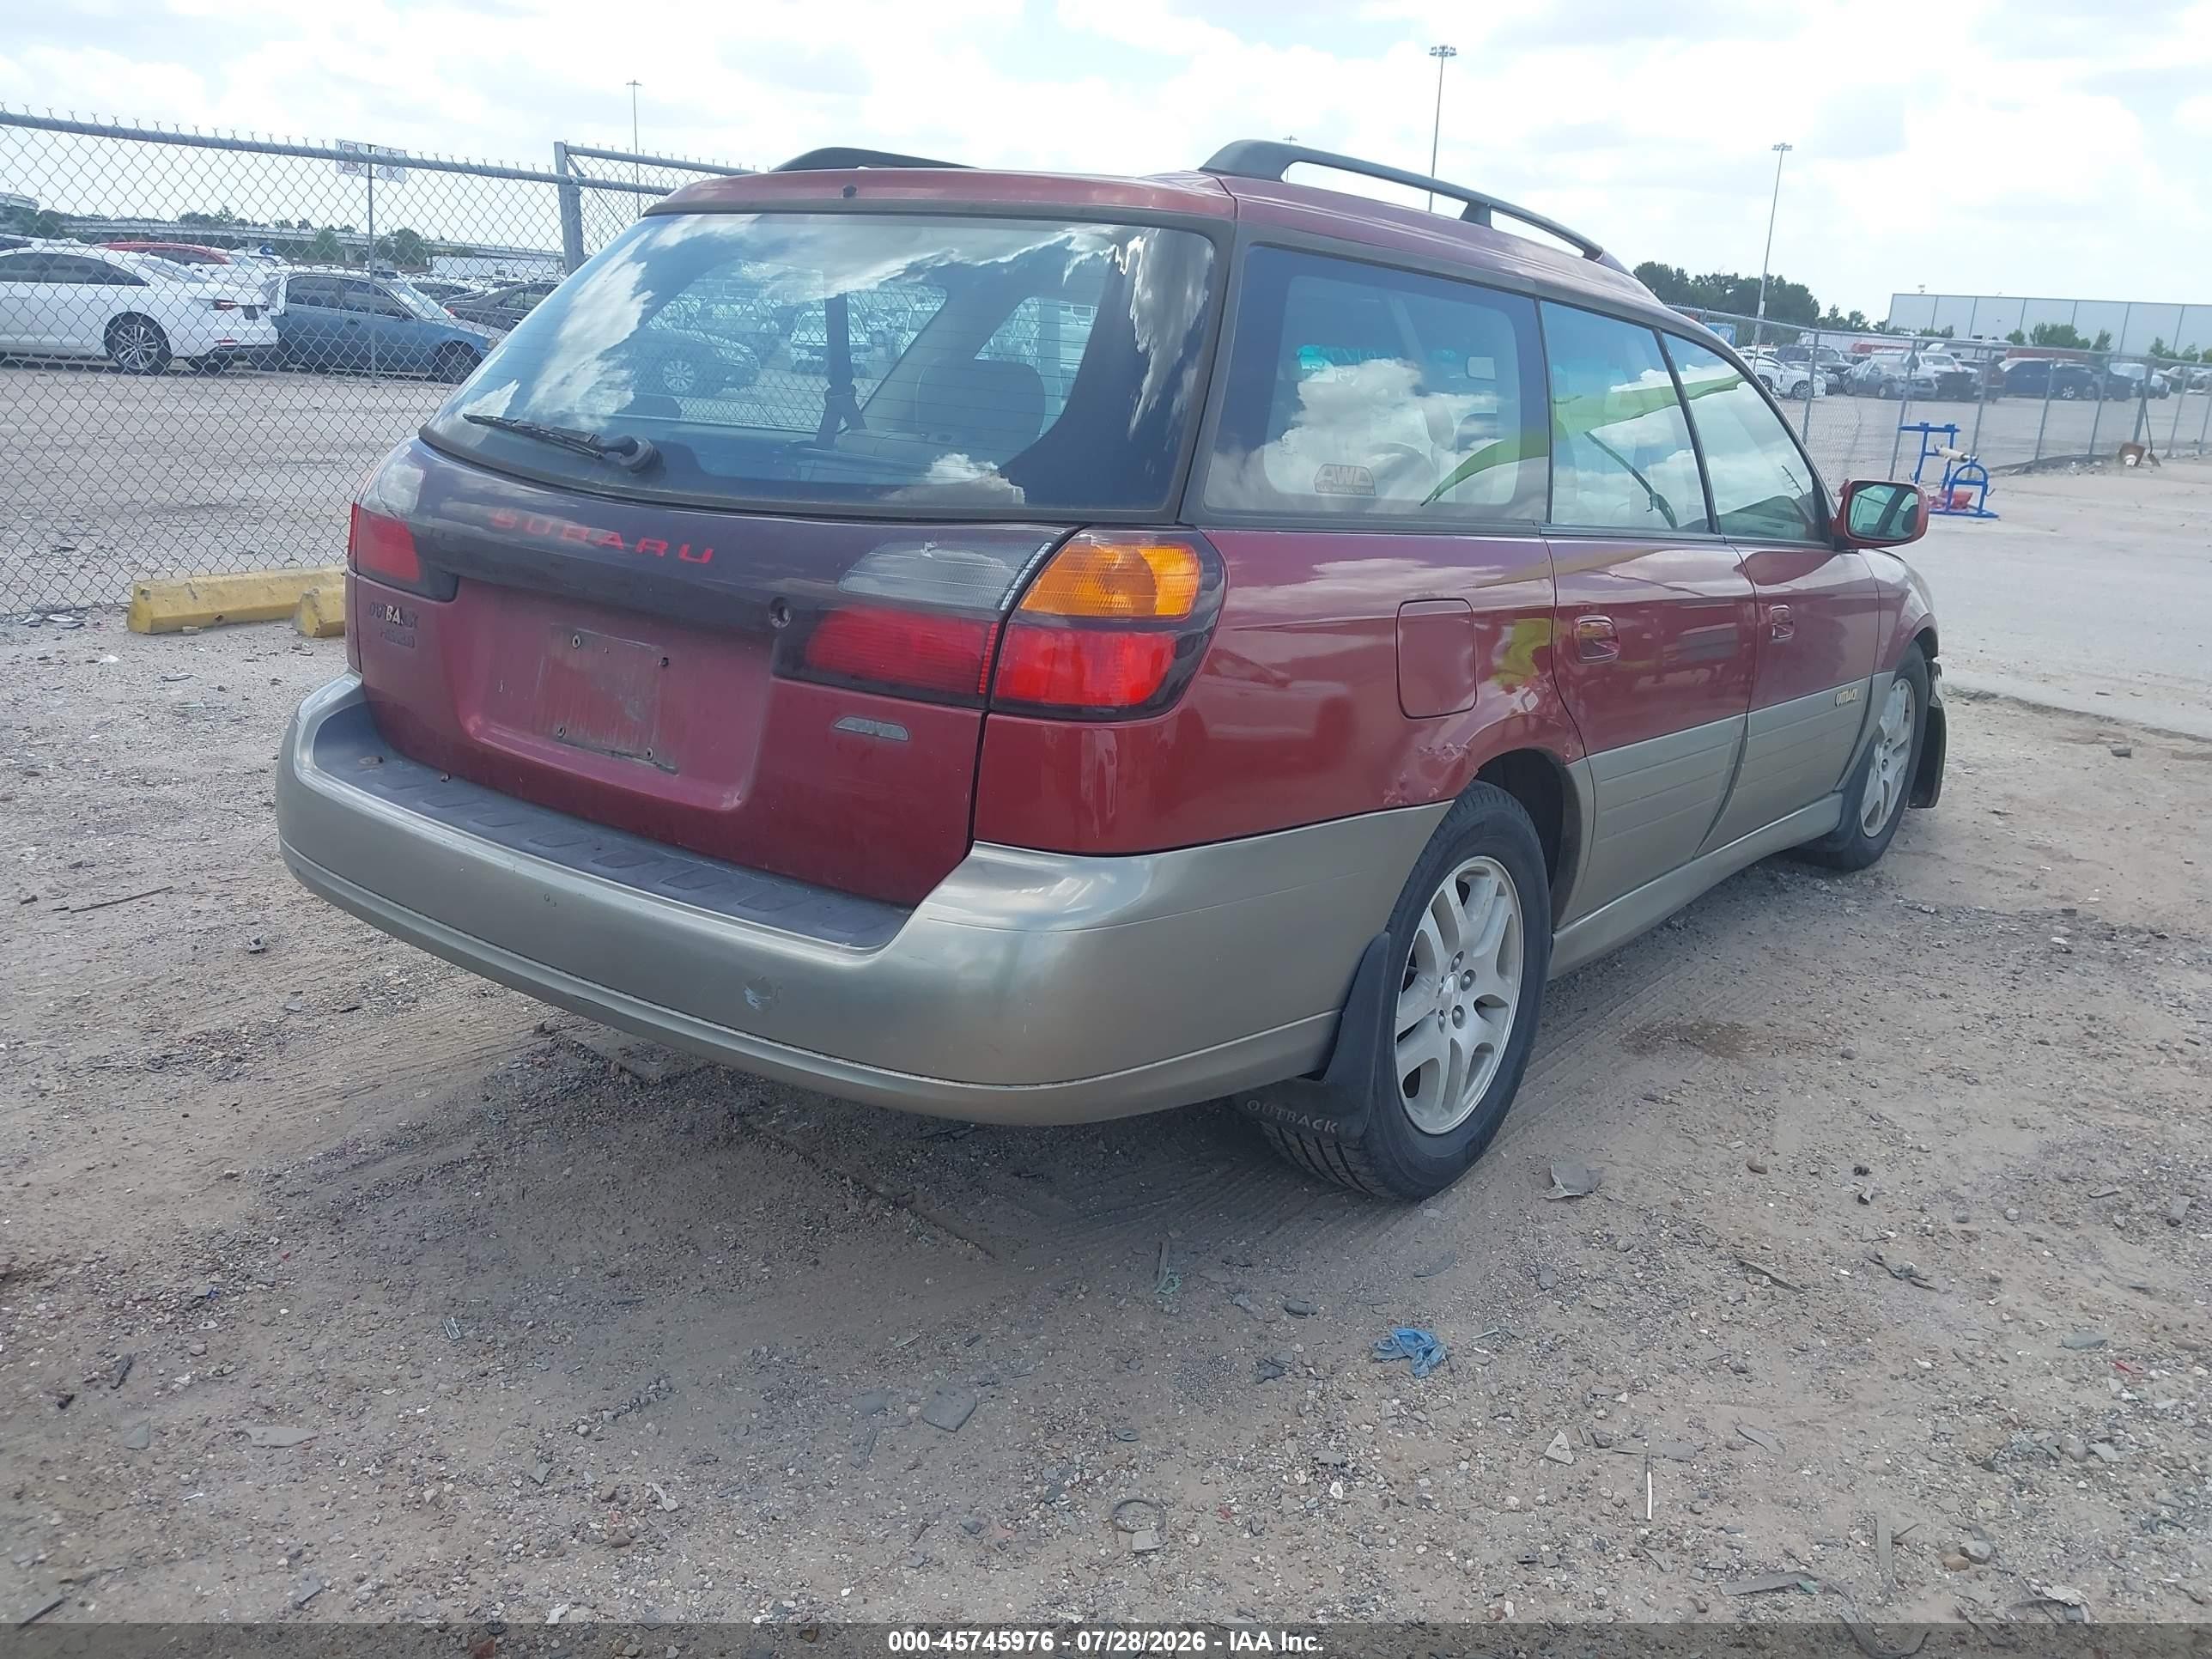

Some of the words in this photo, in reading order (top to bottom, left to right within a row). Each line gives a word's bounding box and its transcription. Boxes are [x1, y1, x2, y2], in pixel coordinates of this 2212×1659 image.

[1315, 465, 1374, 486] AWD
[489, 507, 714, 563] SUBARU
[1247, 1100, 1339, 1133] OUTBACK
